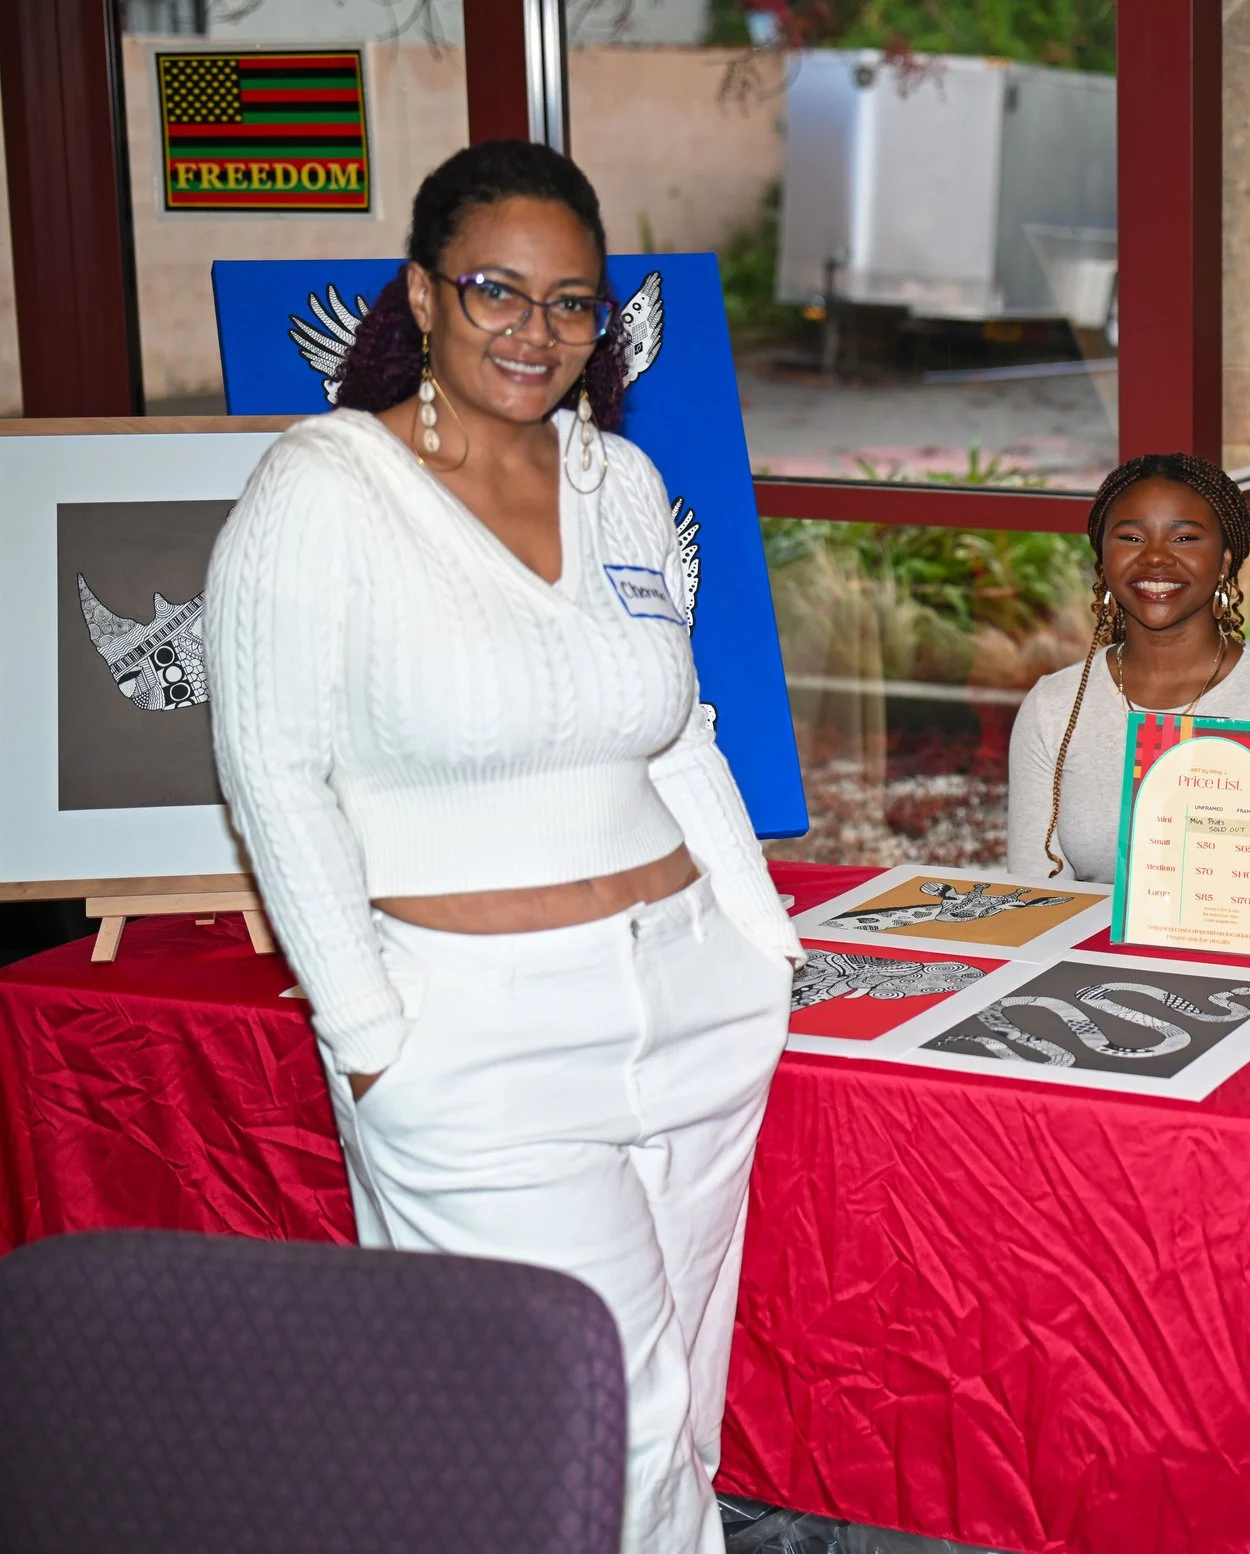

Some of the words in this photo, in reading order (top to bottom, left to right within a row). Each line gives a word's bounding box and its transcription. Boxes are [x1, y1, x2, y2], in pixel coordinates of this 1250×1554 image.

[174, 162, 361, 191] FREEDOM
[1178, 775, 1214, 789] Price
[1216, 777, 1243, 791] List
[1156, 815, 1173, 823] Mini
[1149, 838, 1171, 846] Small
[1146, 863, 1176, 872] Medium
[1192, 928, 1216, 936] depend
